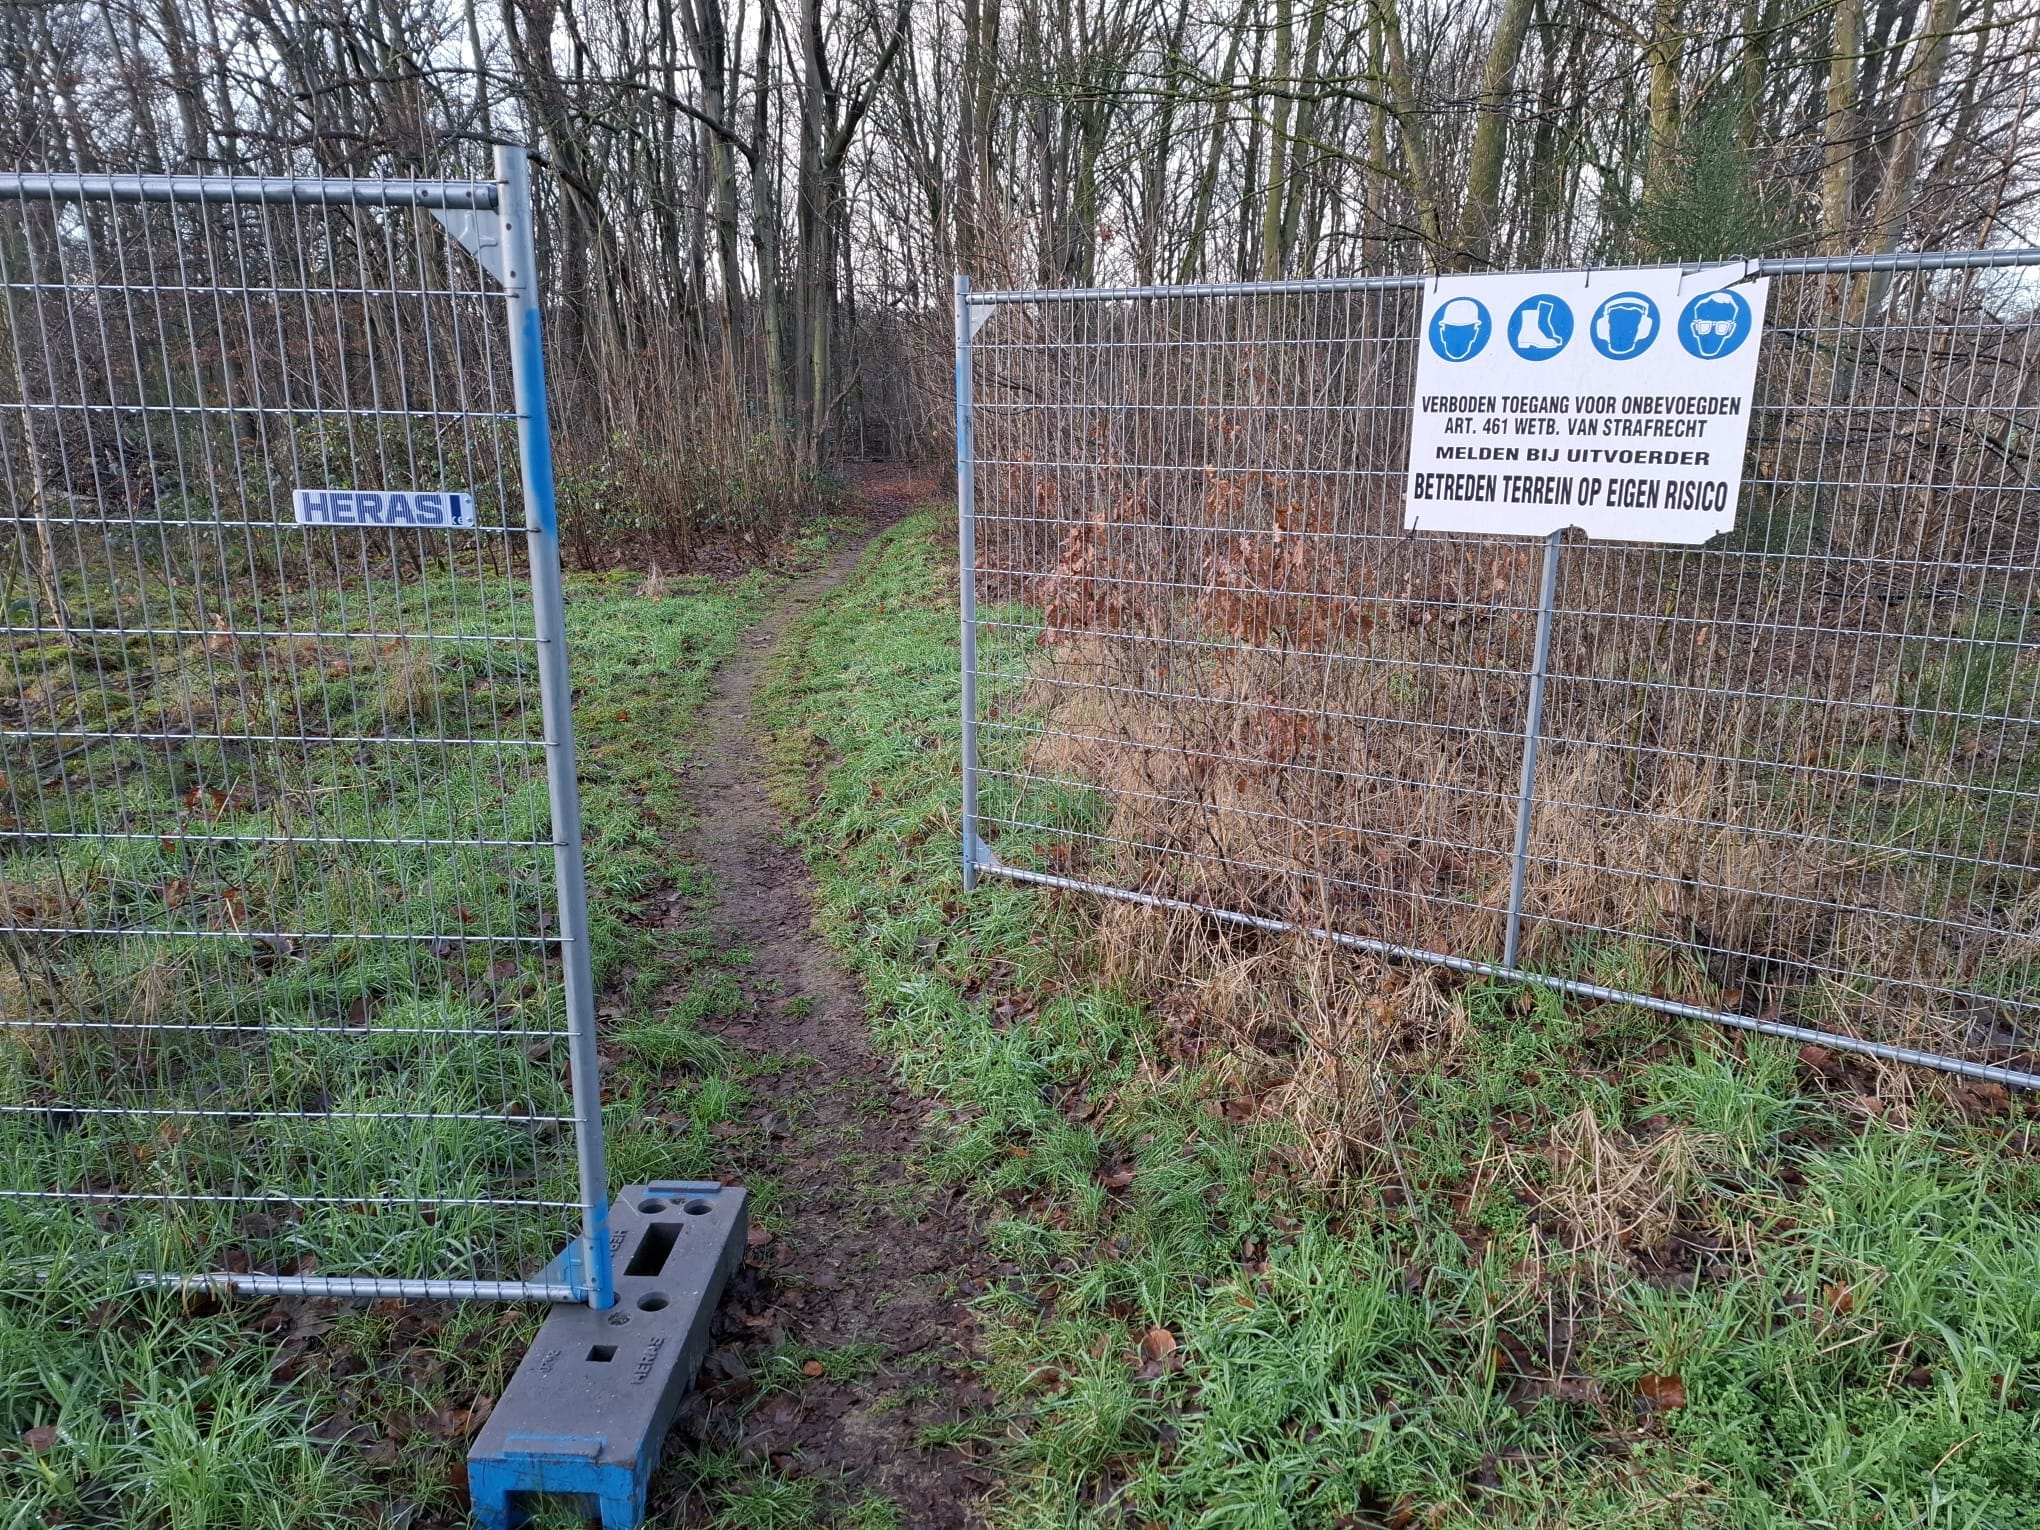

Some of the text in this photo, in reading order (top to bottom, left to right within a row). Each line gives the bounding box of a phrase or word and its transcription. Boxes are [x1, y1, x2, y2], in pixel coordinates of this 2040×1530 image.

[1423, 396, 1741, 415] VERBODEN TOEGANG VOOR ONBEVOEGDEN
[1445, 417, 1707, 437] ART. 461 WETB. VAN STRAFRECHT
[1436, 447, 1709, 465] MELDEN BIJ UITVOERDER
[1414, 473, 1728, 512] BETREDEN TERREIN OP EIGEN RISICO
[630, 1336, 665, 1386] HERAS
